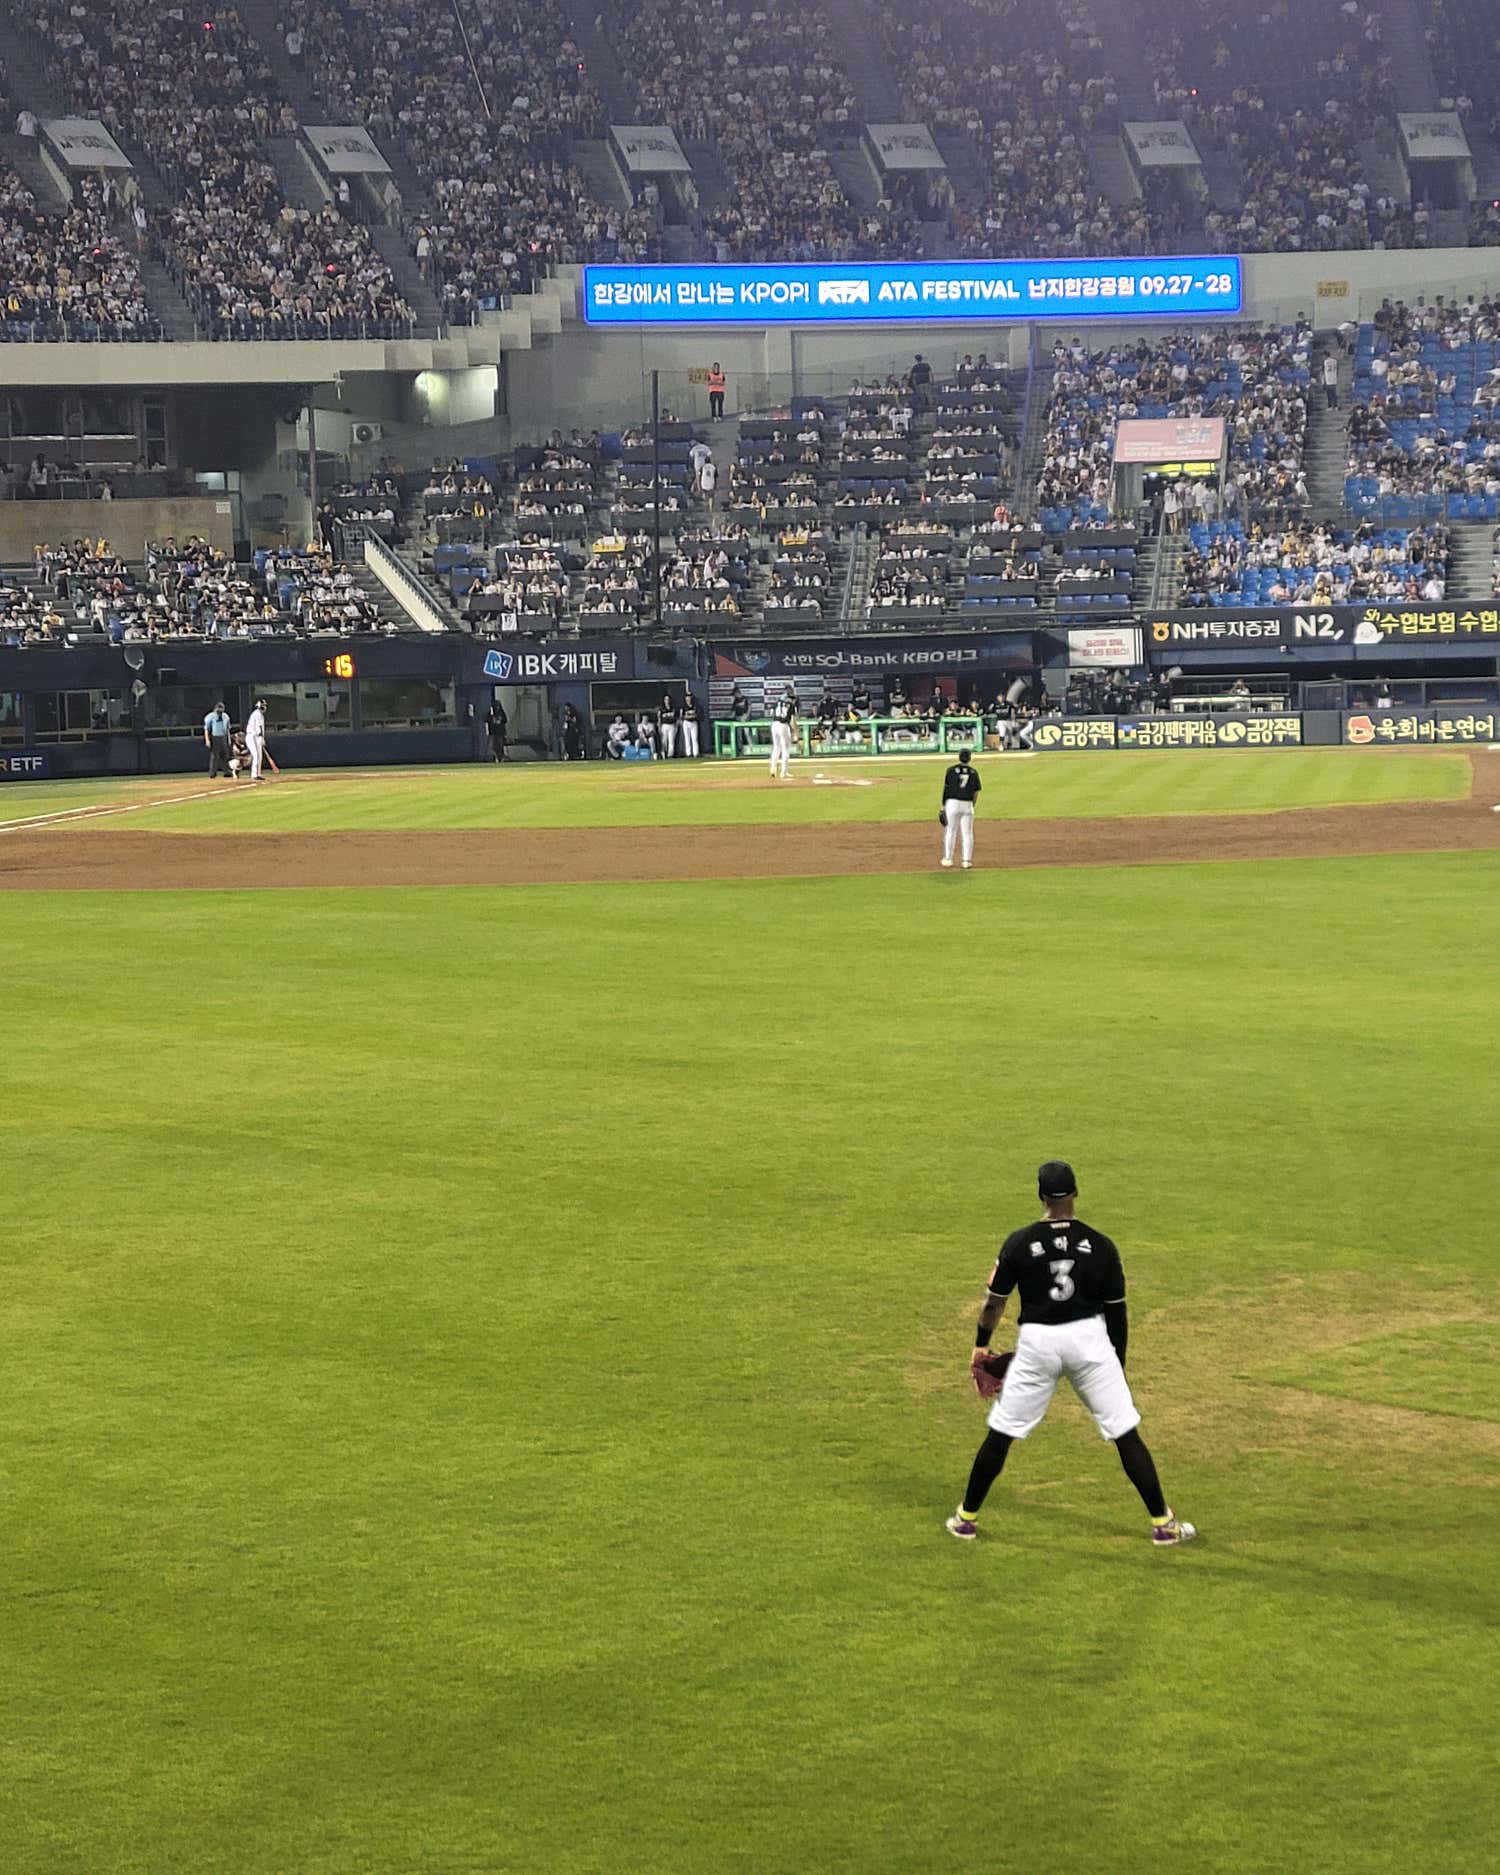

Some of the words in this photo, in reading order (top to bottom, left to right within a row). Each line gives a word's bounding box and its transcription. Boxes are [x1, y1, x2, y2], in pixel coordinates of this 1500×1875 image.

[593, 282, 671, 305] 한강에서
[677, 282, 735, 304] 만나는
[740, 282, 810, 303] KPOP!
[878, 281, 919, 301] ATA
[922, 280, 1021, 300] FESTIVAL
[1028, 276, 1136, 298] 난지한강공원
[1173, 619, 1281, 640] NH투자증권
[1380, 611, 1456, 635] 수협보험
[1459, 610, 1500, 633] 수협
[782, 654, 813, 667] 신한
[850, 652, 898, 666] Bank
[902, 651, 945, 665] KBO
[946, 649, 978, 662] 리그
[1062, 720, 1115, 746] 금강주택
[1246, 718, 1301, 743] 금강주택
[10, 756, 43, 771] ETF
[959, 773, 970, 788] 7
[1049, 1259, 1076, 1302] 3
